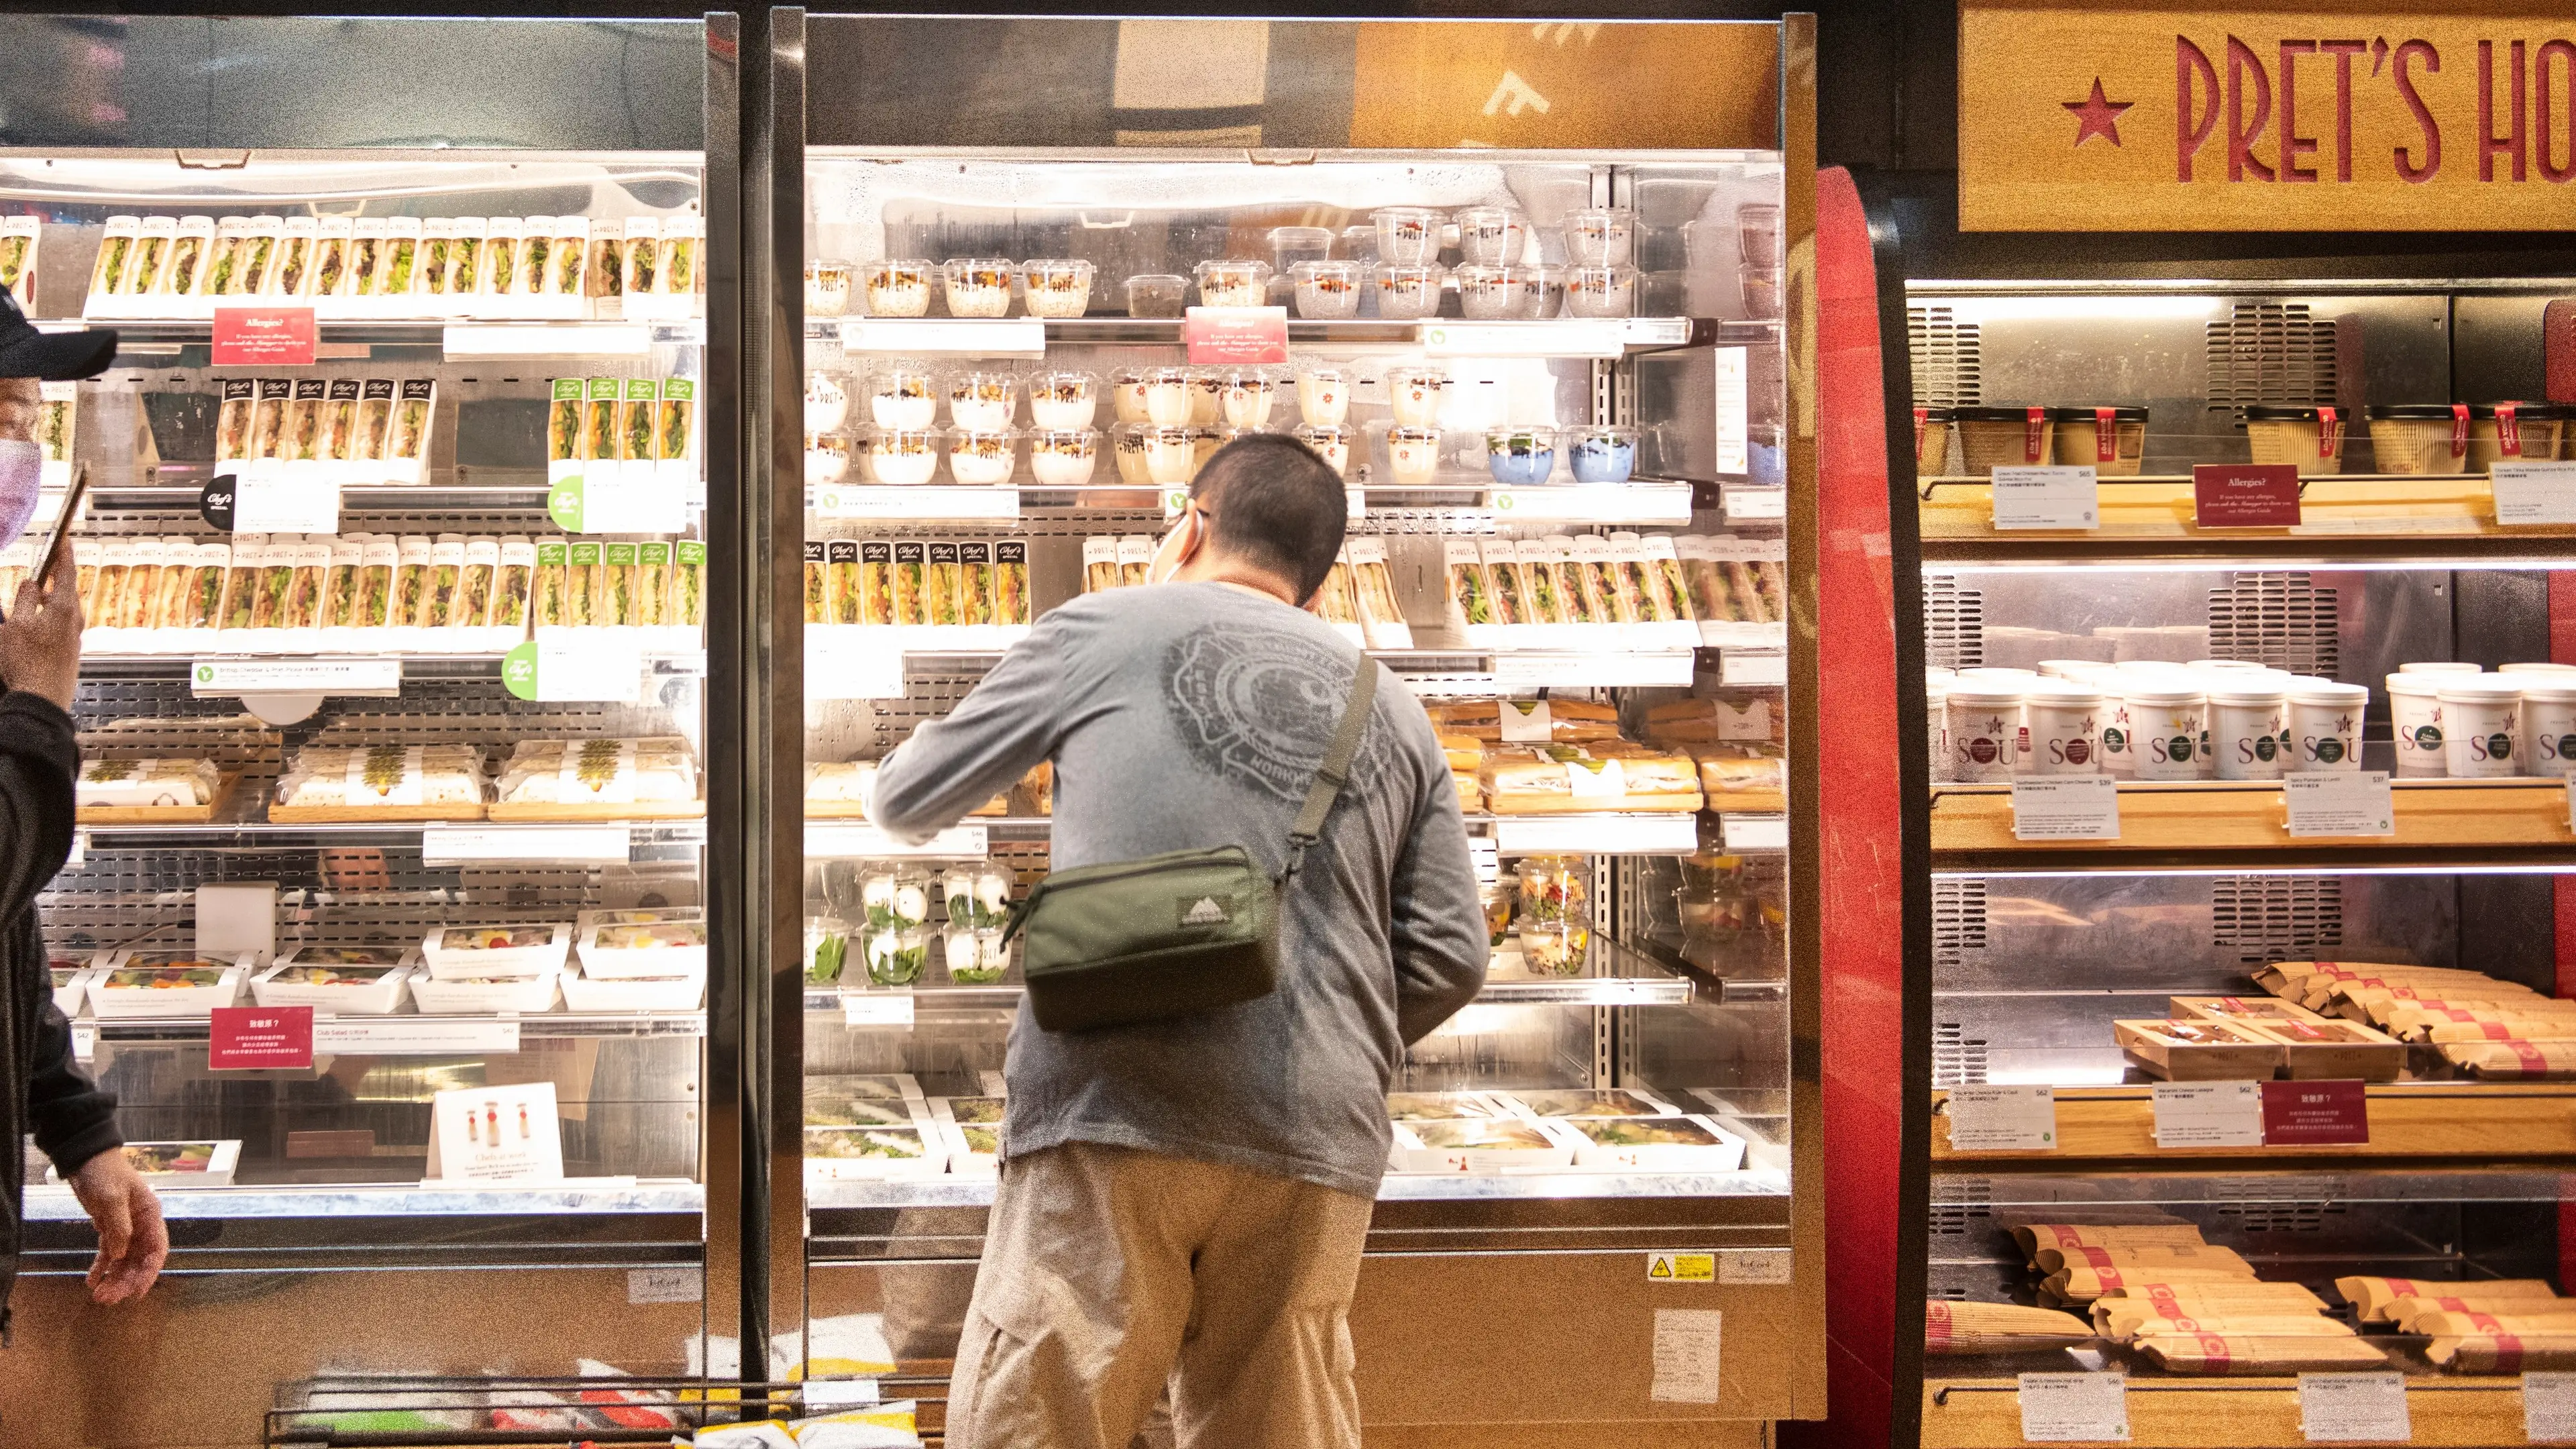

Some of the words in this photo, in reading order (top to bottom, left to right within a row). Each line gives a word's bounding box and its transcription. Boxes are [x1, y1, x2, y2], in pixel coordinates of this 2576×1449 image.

[2176, 34, 2441, 184] PRET'S
[820, 281, 838, 292] PRET
[246, 319, 284, 329] Allergies?
[1219, 319, 1254, 329] Allergies?
[227, 382, 250, 391] Chef's
[265, 382, 288, 392] Chef's
[299, 383, 322, 392] Chef's
[333, 384, 356, 392] Chef's
[368, 382, 390, 392] Chef's
[406, 382, 429, 392] Chef's
[557, 384, 580, 393] Chef's
[593, 384, 615, 393] Chef's
[630, 384, 652, 394] Chef's
[667, 384, 690, 393] Chef's
[820, 391, 837, 404] PRET
[980, 447, 998, 459] PRET
[1124, 442, 1141, 454] PRET
[2228, 478, 2266, 488] Allergies?
[207, 493, 232, 506] Chef's
[554, 496, 578, 508] Chef's
[574, 549, 596, 557] Chef's
[610, 549, 632, 558] Chef's
[643, 548, 665, 557] Chef's
[680, 547, 702, 557] Chef's
[832, 545, 854, 555] Chef's
[865, 546, 887, 555] Chef's
[898, 546, 920, 555] Chef's
[932, 546, 954, 555] Chef's
[963, 546, 985, 555] Chef's
[1000, 546, 1021, 555] Chef's
[508, 663, 533, 676] Chef's
[2301, 1094, 2330, 1103] 致敏原？
